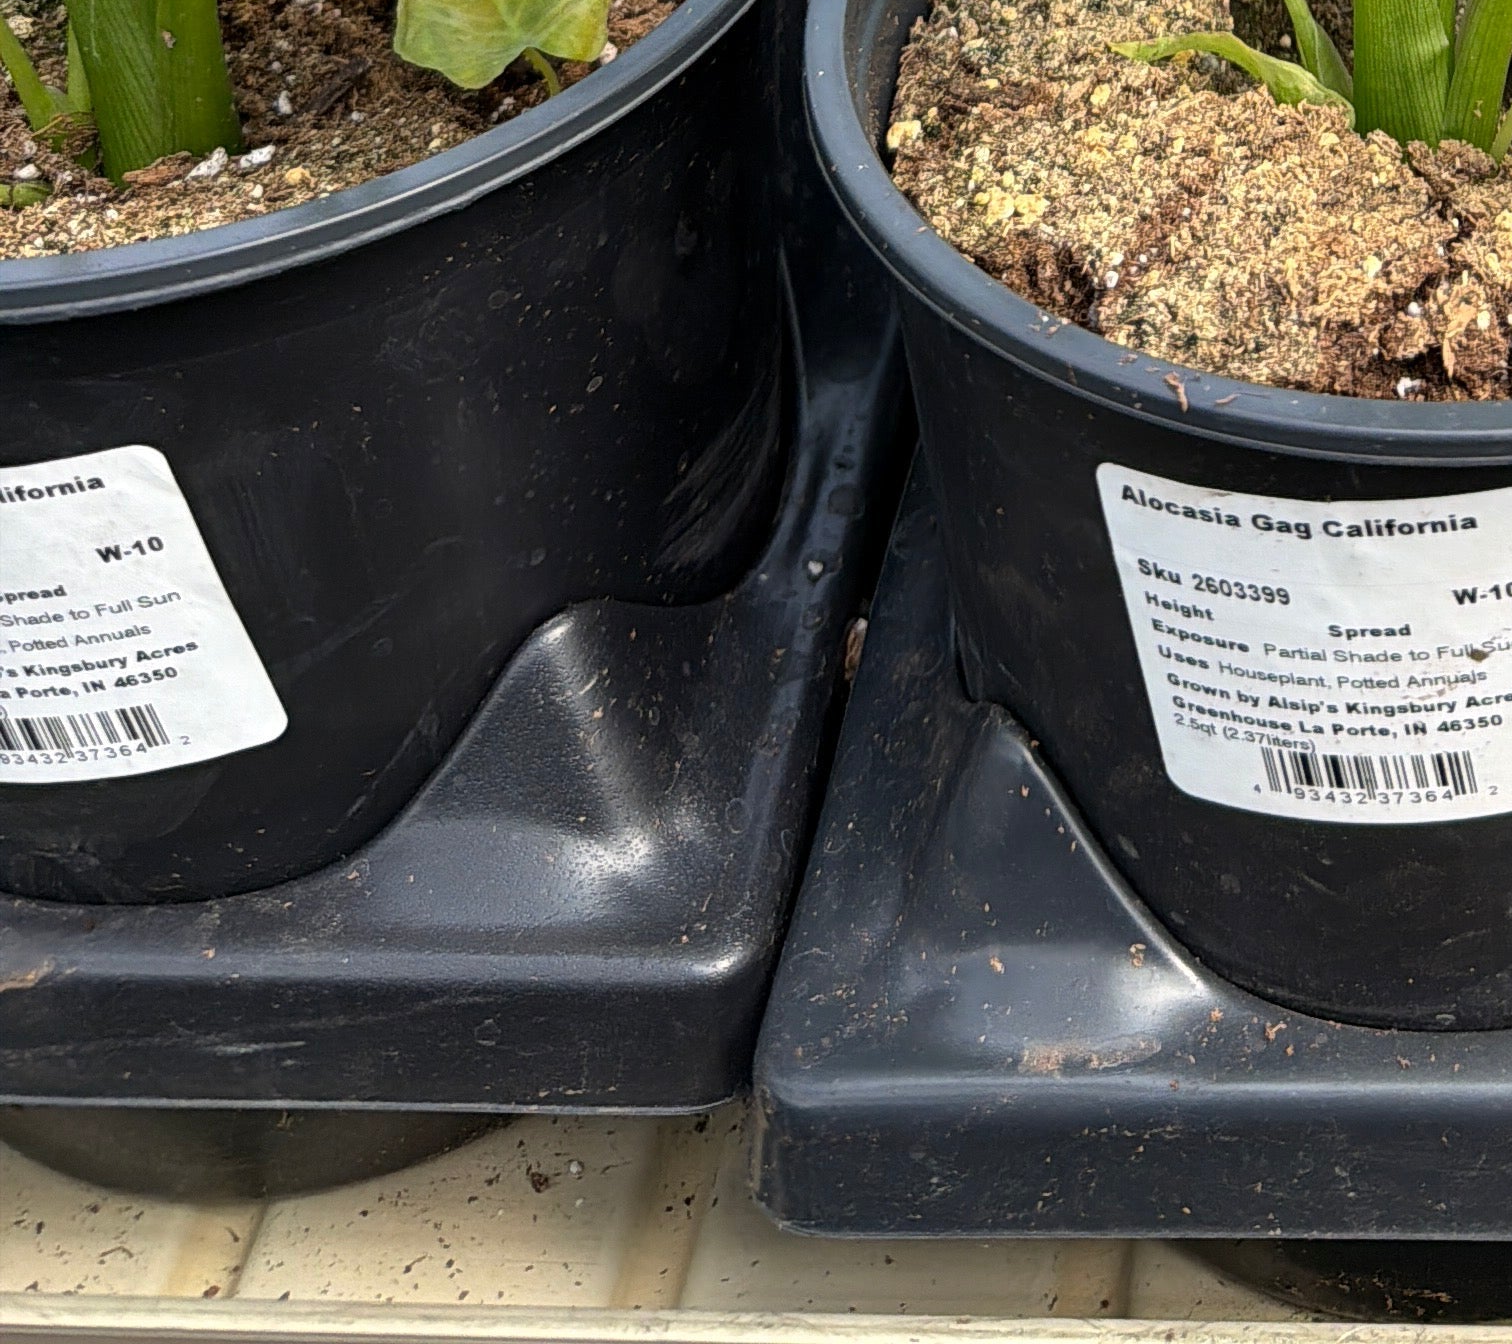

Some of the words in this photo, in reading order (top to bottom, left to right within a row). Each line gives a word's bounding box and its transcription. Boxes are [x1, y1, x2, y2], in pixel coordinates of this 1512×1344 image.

[1121, 484, 1242, 528] Alocasia
[1251, 514, 1312, 540] Gag
[1322, 515, 1478, 538] California
[95, 536, 164, 563] W-10
[0, 584, 67, 605] pread
[1137, 558, 1182, 585] Sku
[1191, 573, 1290, 605] 2603399
[0, 612, 64, 627] Shade
[69, 609, 90, 620] to
[94, 598, 133, 617] Full
[137, 590, 181, 609] Sun
[1144, 591, 1215, 621] Height
[8, 636, 68, 652] Potted
[75, 624, 152, 646] Annuals
[1151, 618, 1250, 653] Exposure
[1263, 643, 1327, 662] Partial
[1333, 649, 1403, 663] Shade
[1409, 649, 1430, 661] to
[1436, 644, 1475, 659] Full
[1328, 624, 1412, 640] Spread
[22, 656, 128, 677] Kingsbury
[136, 640, 199, 663] Acres
[1157, 644, 1209, 669] Uses
[1219, 661, 1332, 689] Houseplant,
[1337, 675, 1400, 689] Potted
[1407, 670, 1488, 688] Annuals
[15, 686, 79, 698] Porte,
[81, 679, 106, 693] IN
[114, 666, 178, 688] 46350
[1167, 672, 1231, 699] Grown
[1236, 690, 1260, 708] by
[1268, 695, 1339, 715] Alsip's
[1345, 700, 1457, 717] Kingsbury
[1172, 695, 1292, 731] Greenhouse
[1299, 721, 1324, 735] La
[1332, 723, 1398, 739] Porte,
[1404, 722, 1427, 736] IN
[1436, 714, 1503, 732] 46350
[1174, 712, 1218, 737] 2.5qt
[1223, 725, 1316, 753] (2.37liters)
[75, 744, 147, 762] 37364
[181, 736, 191, 745] 2
[1253, 783, 1262, 794] 4
[1294, 787, 1368, 805] 93432
[1377, 789, 1453, 804] 37364
[1488, 786, 1499, 796] 2
